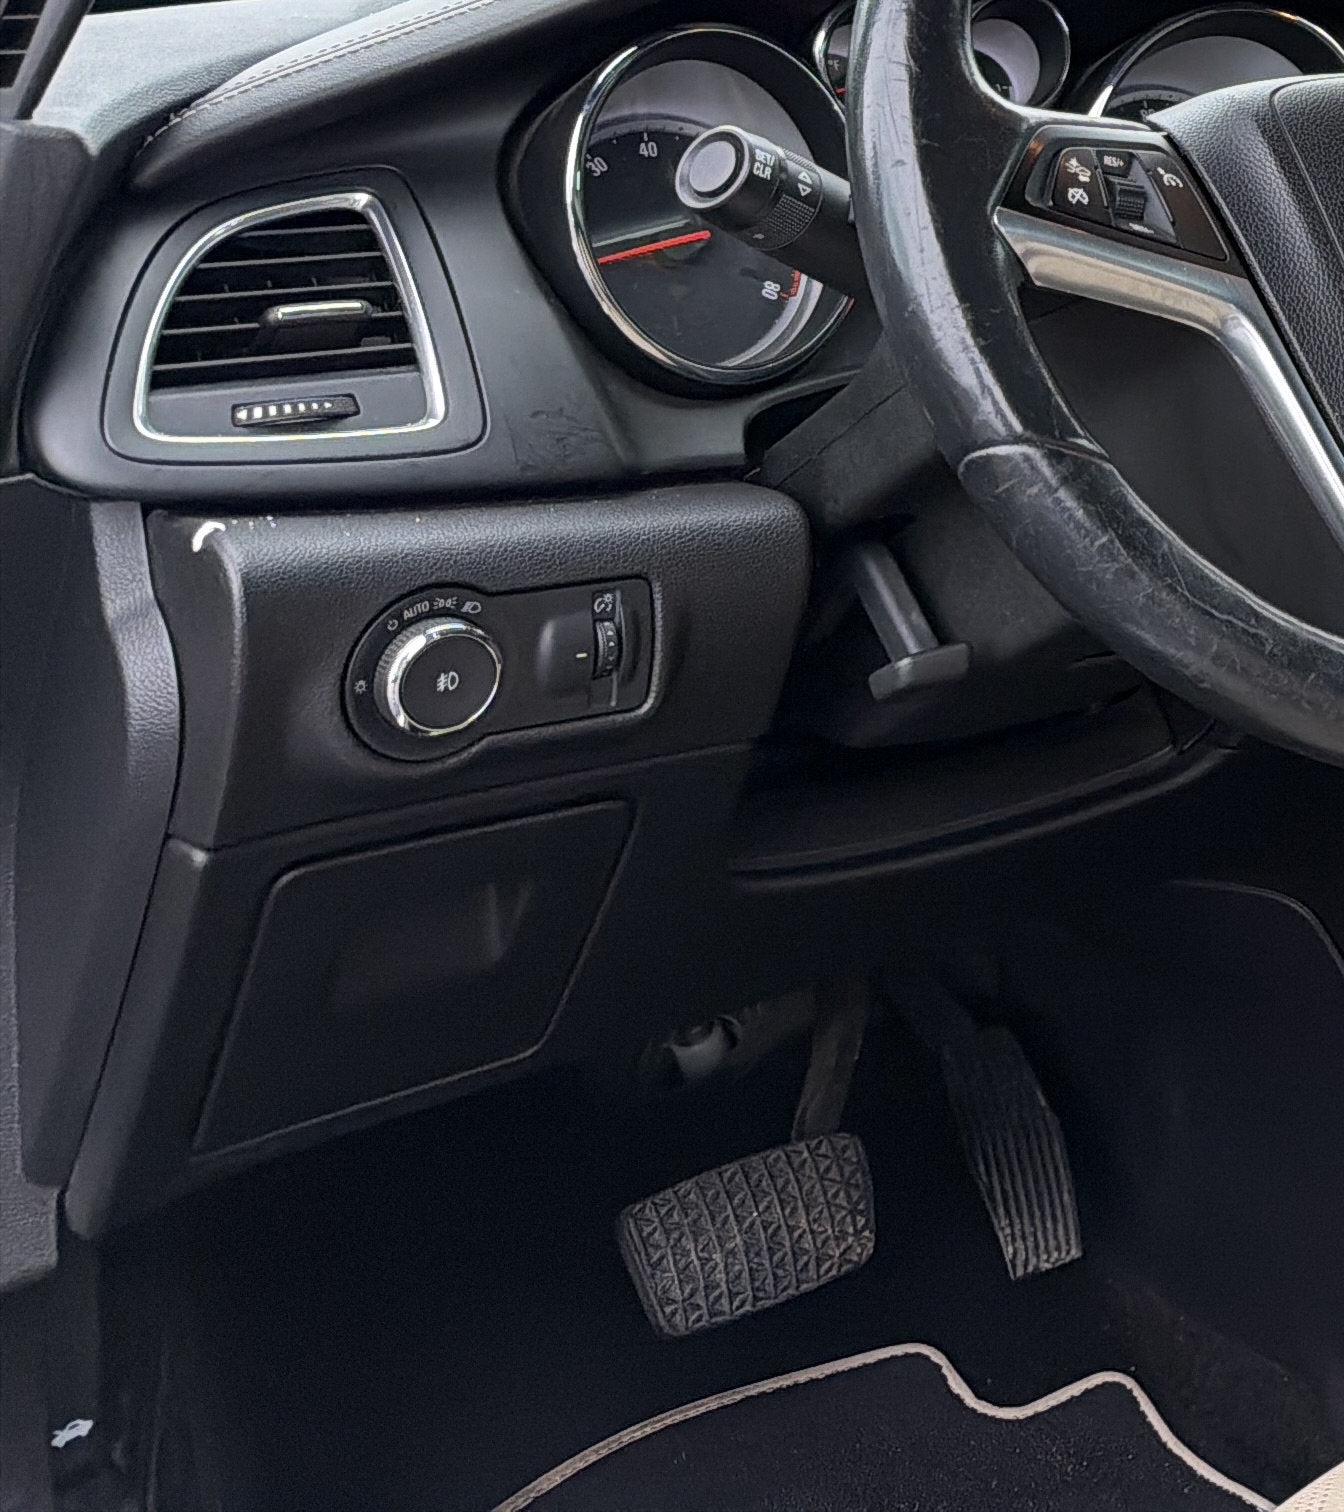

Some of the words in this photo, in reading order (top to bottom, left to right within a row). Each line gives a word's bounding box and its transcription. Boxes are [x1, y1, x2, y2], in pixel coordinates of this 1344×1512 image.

[638, 141, 658, 158] 40
[586, 156, 609, 178] 30
[753, 161, 773, 181] CLR
[761, 280, 781, 300] 80
[403, 600, 430, 621] AUTO
